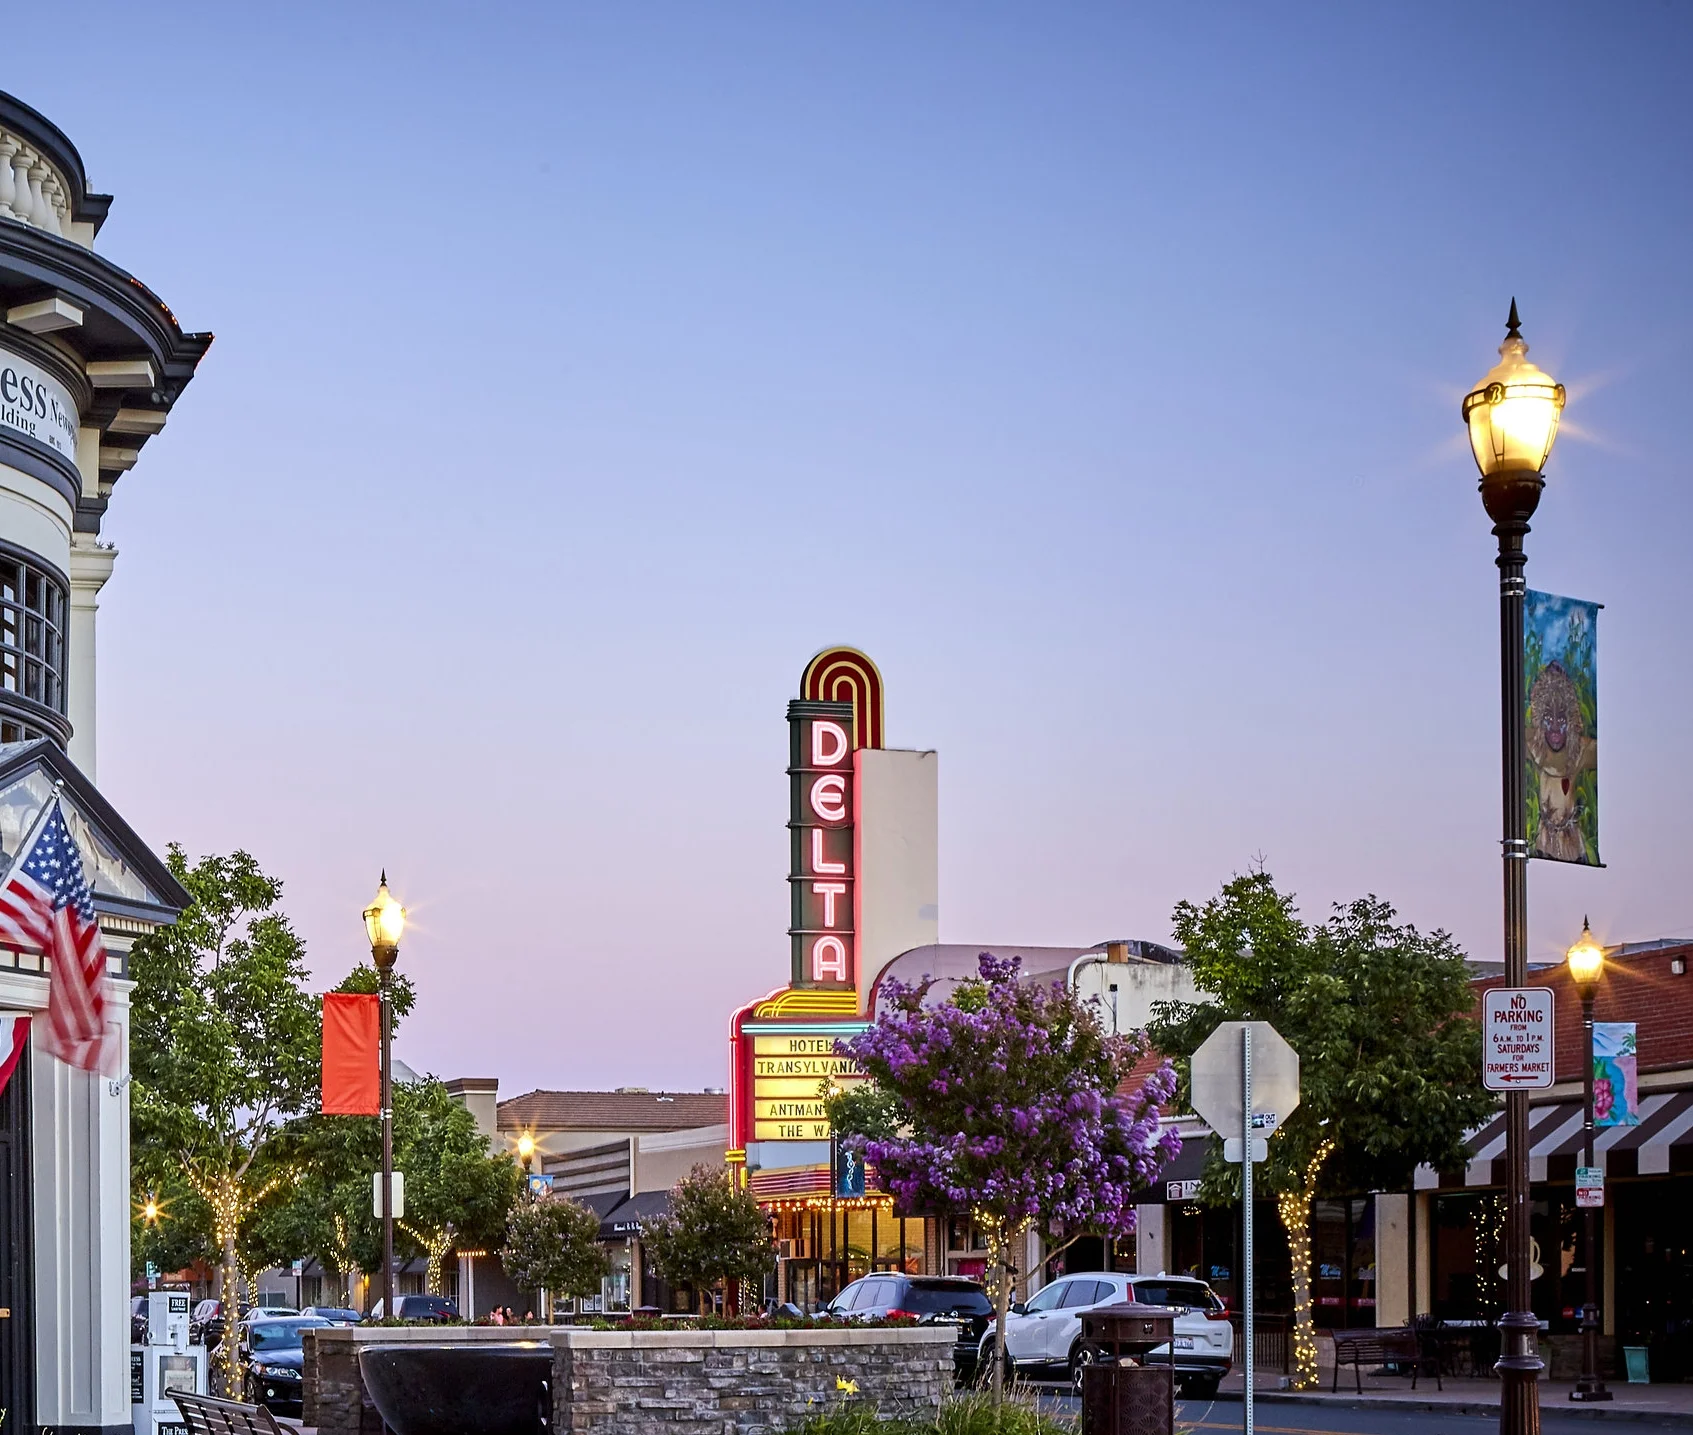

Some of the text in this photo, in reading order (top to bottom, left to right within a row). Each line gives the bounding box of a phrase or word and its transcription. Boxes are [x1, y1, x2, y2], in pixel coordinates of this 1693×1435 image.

[810, 719, 848, 982] DELTA
[1510, 997, 1526, 1009] NO
[1494, 1010, 1543, 1023] PARKING
[789, 1039, 832, 1052] HOTEL
[1497, 1043, 1540, 1054] SATURDAYS
[1487, 1062, 1550, 1073] FARMERS MARKET
[779, 1125, 803, 1137] THE
[171, 1299, 186, 1307] FREE
